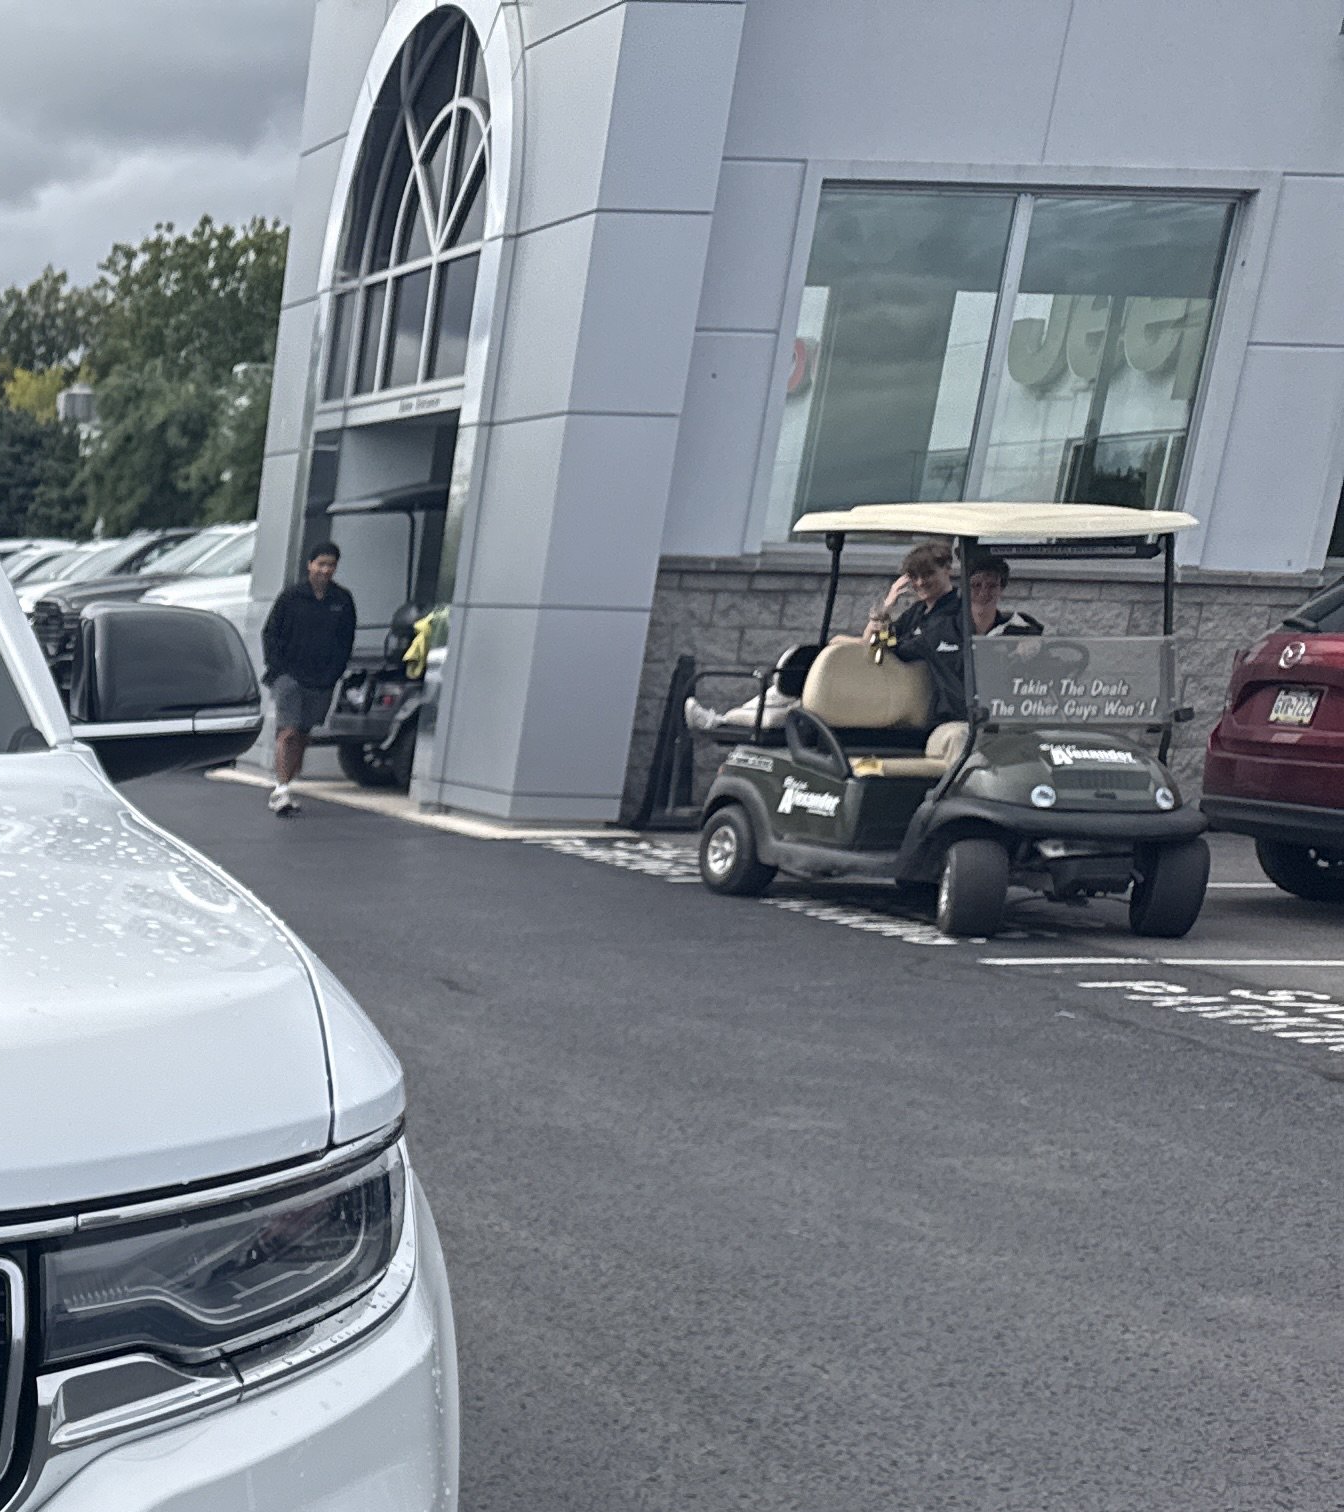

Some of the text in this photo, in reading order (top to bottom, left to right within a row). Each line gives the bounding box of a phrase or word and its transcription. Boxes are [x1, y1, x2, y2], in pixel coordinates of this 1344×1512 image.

[1012, 677, 1130, 697] Takin' The Deals
[991, 698, 1015, 717] The
[1020, 698, 1059, 717] Other
[1063, 699, 1098, 722] Guys
